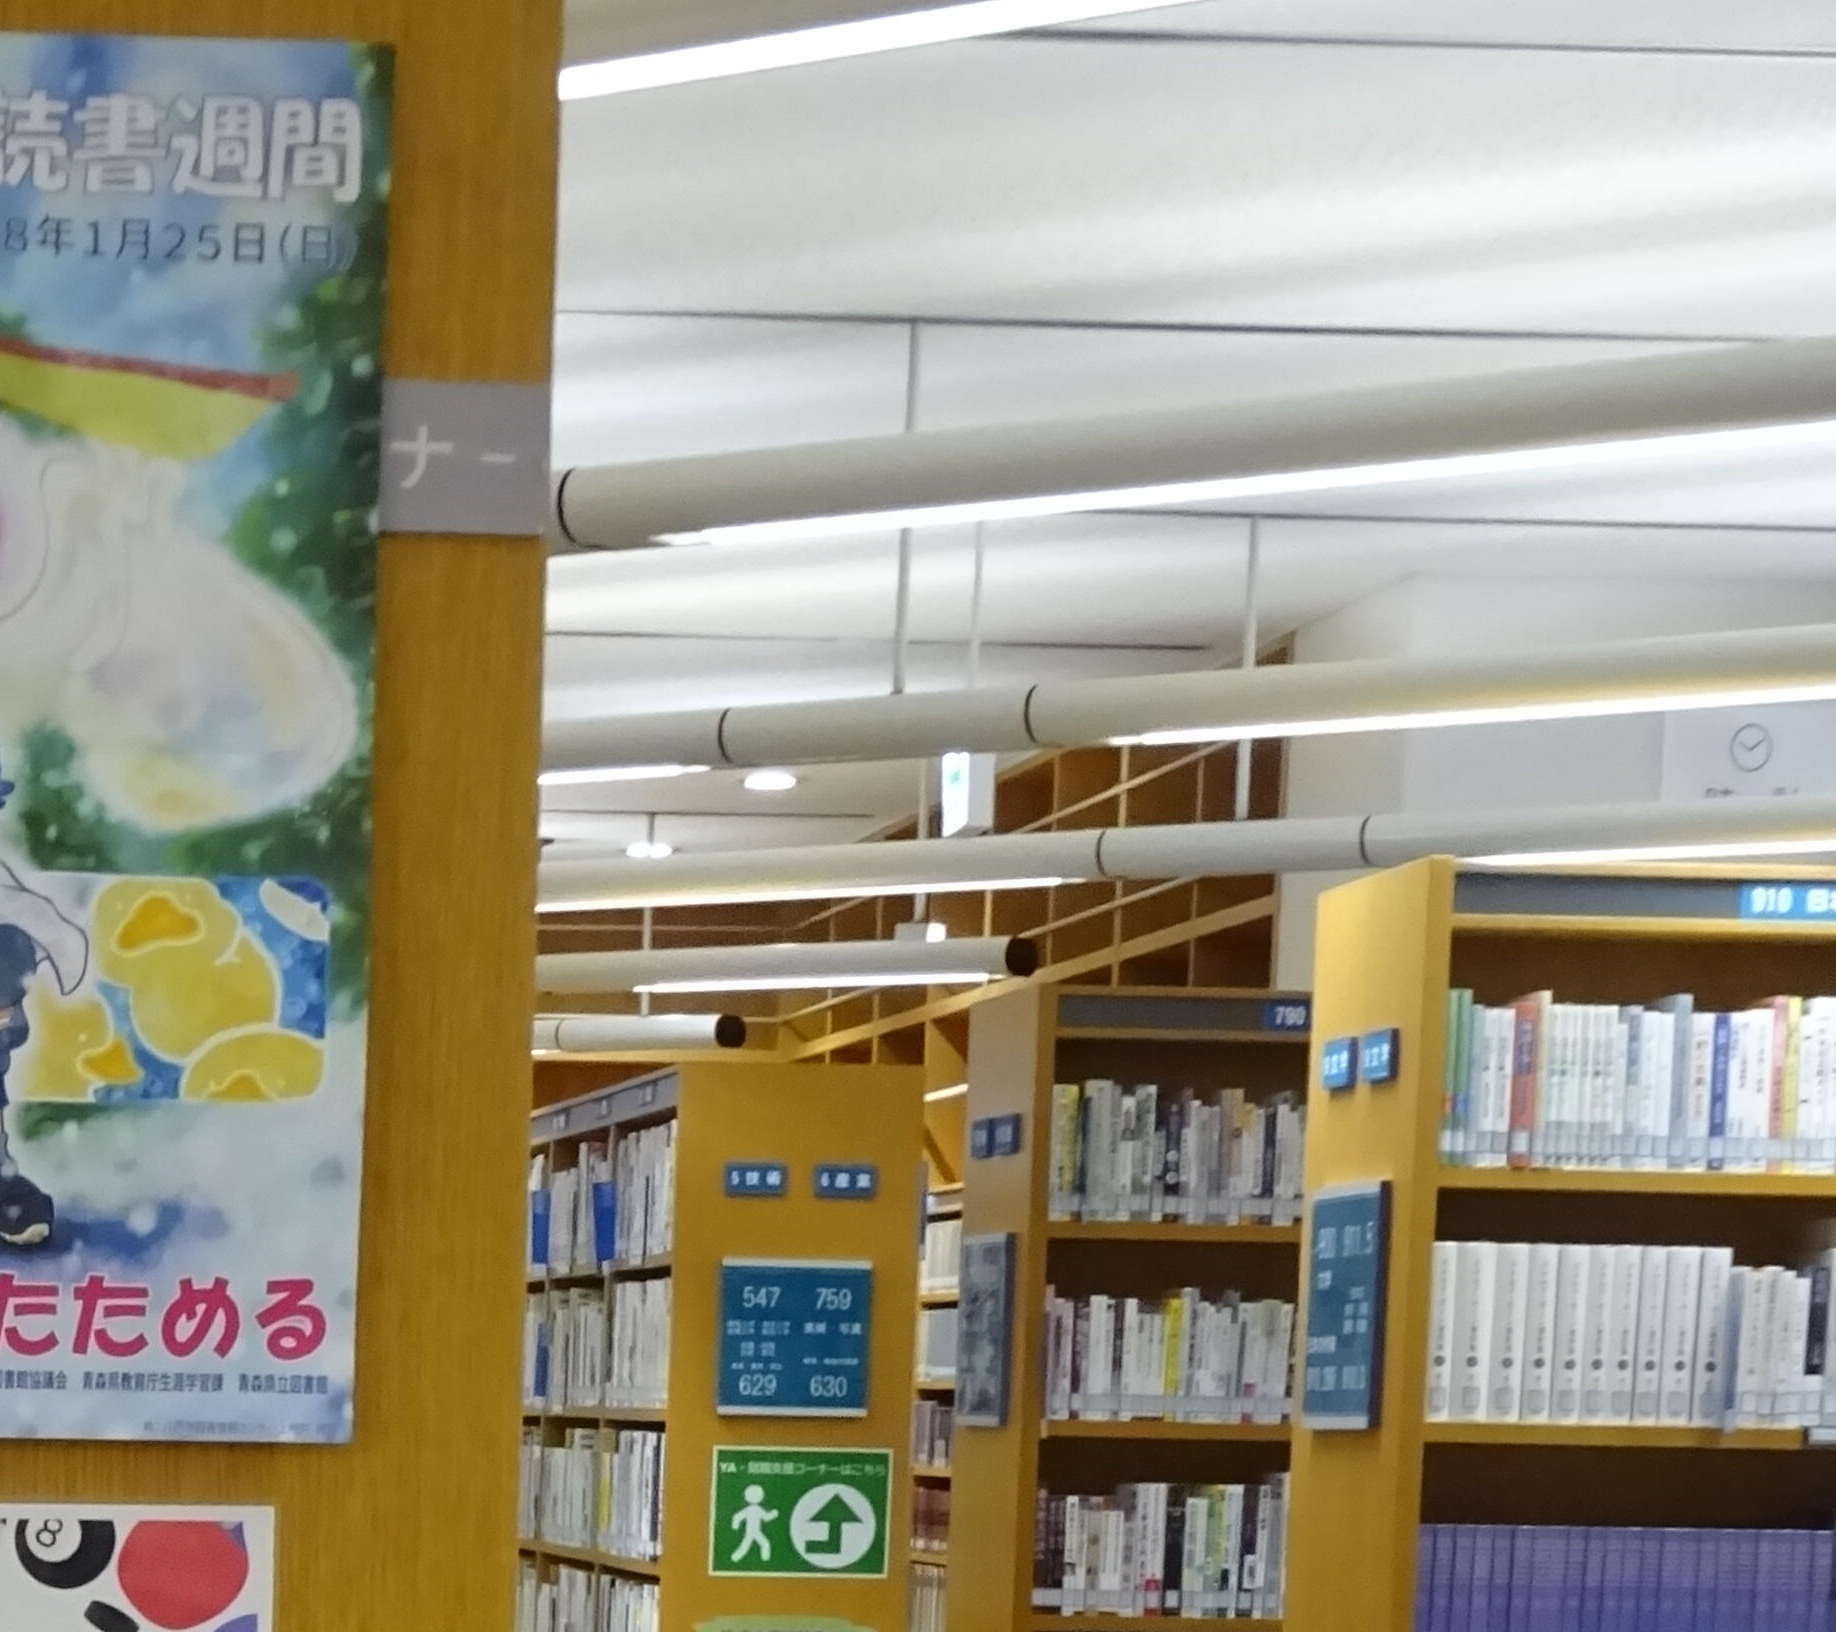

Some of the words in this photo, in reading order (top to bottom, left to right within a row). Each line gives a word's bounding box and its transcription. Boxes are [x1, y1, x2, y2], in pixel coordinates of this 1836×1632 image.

[742, 1286, 781, 1308] 547
[816, 1288, 852, 1310] 759
[739, 1374, 777, 1397] 629
[810, 1375, 848, 1398] 630
